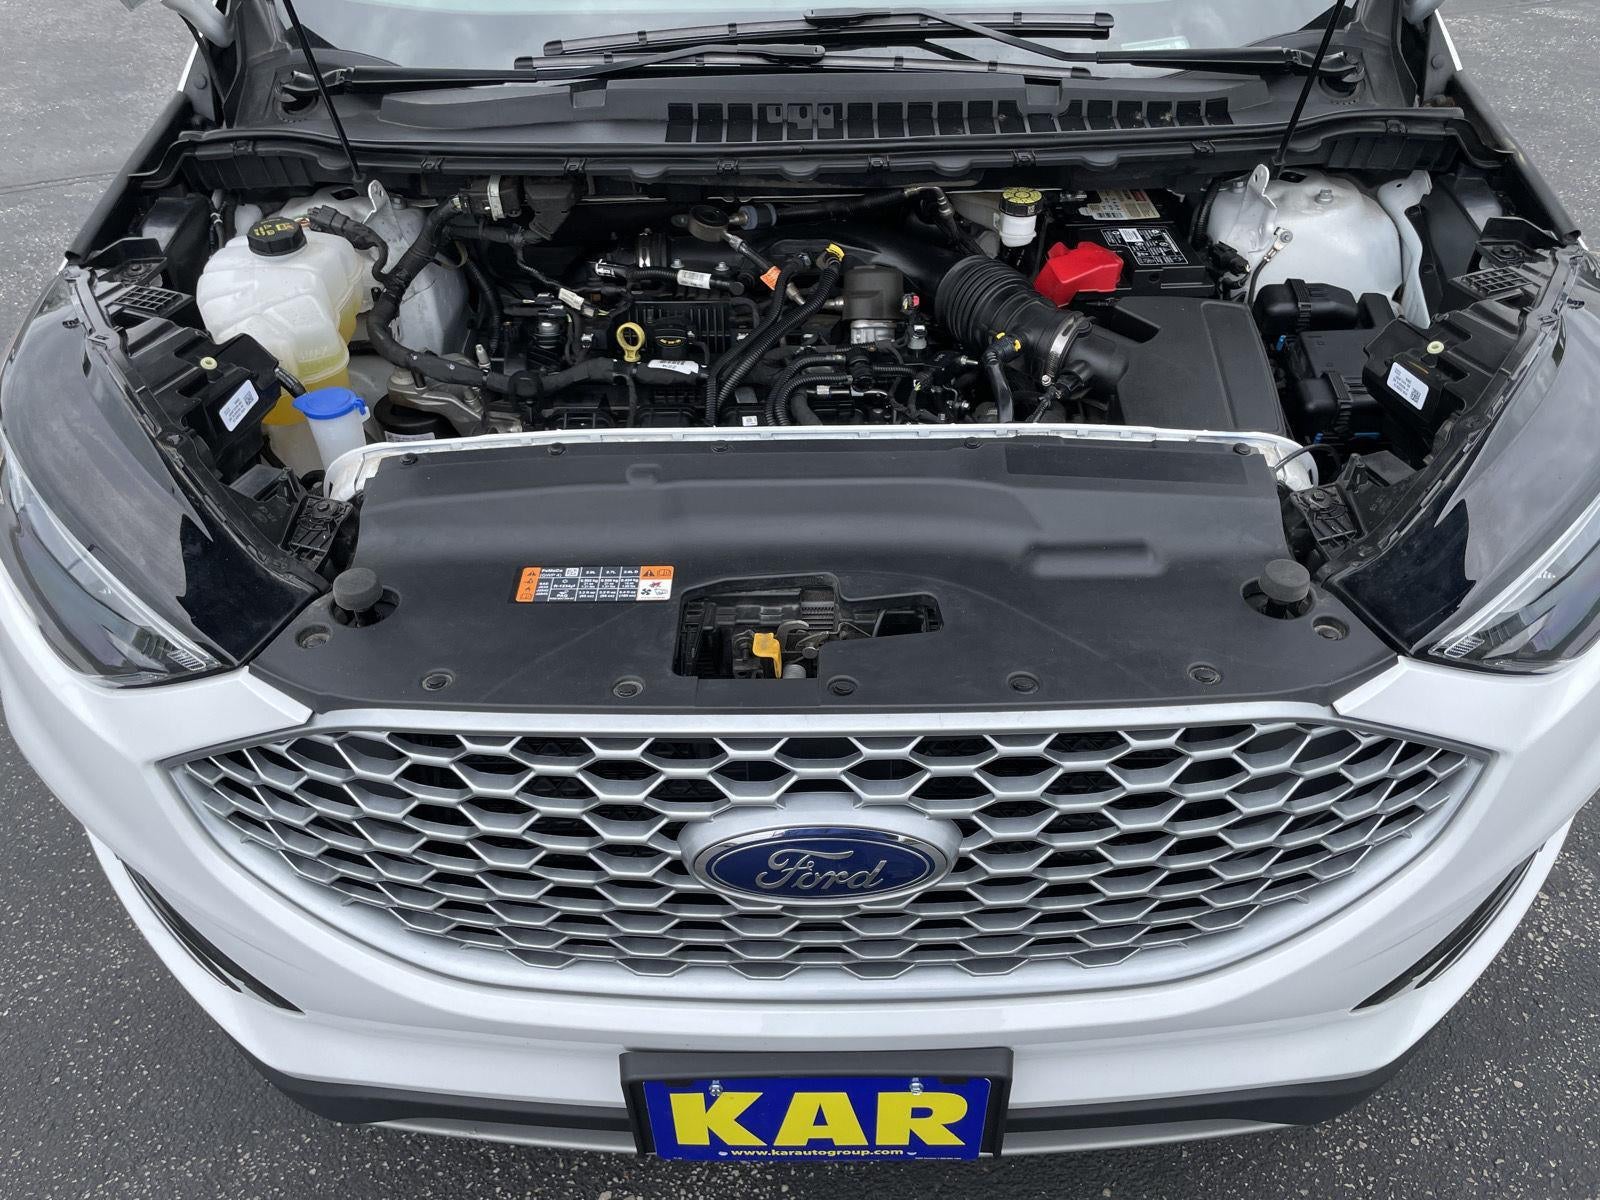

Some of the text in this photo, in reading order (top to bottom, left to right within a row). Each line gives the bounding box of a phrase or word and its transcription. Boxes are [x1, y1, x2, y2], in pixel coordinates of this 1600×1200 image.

[755, 848, 888, 891] Ford
[669, 1091, 968, 1147] KAR
[730, 1148, 904, 1158] www.karautogroup.com
